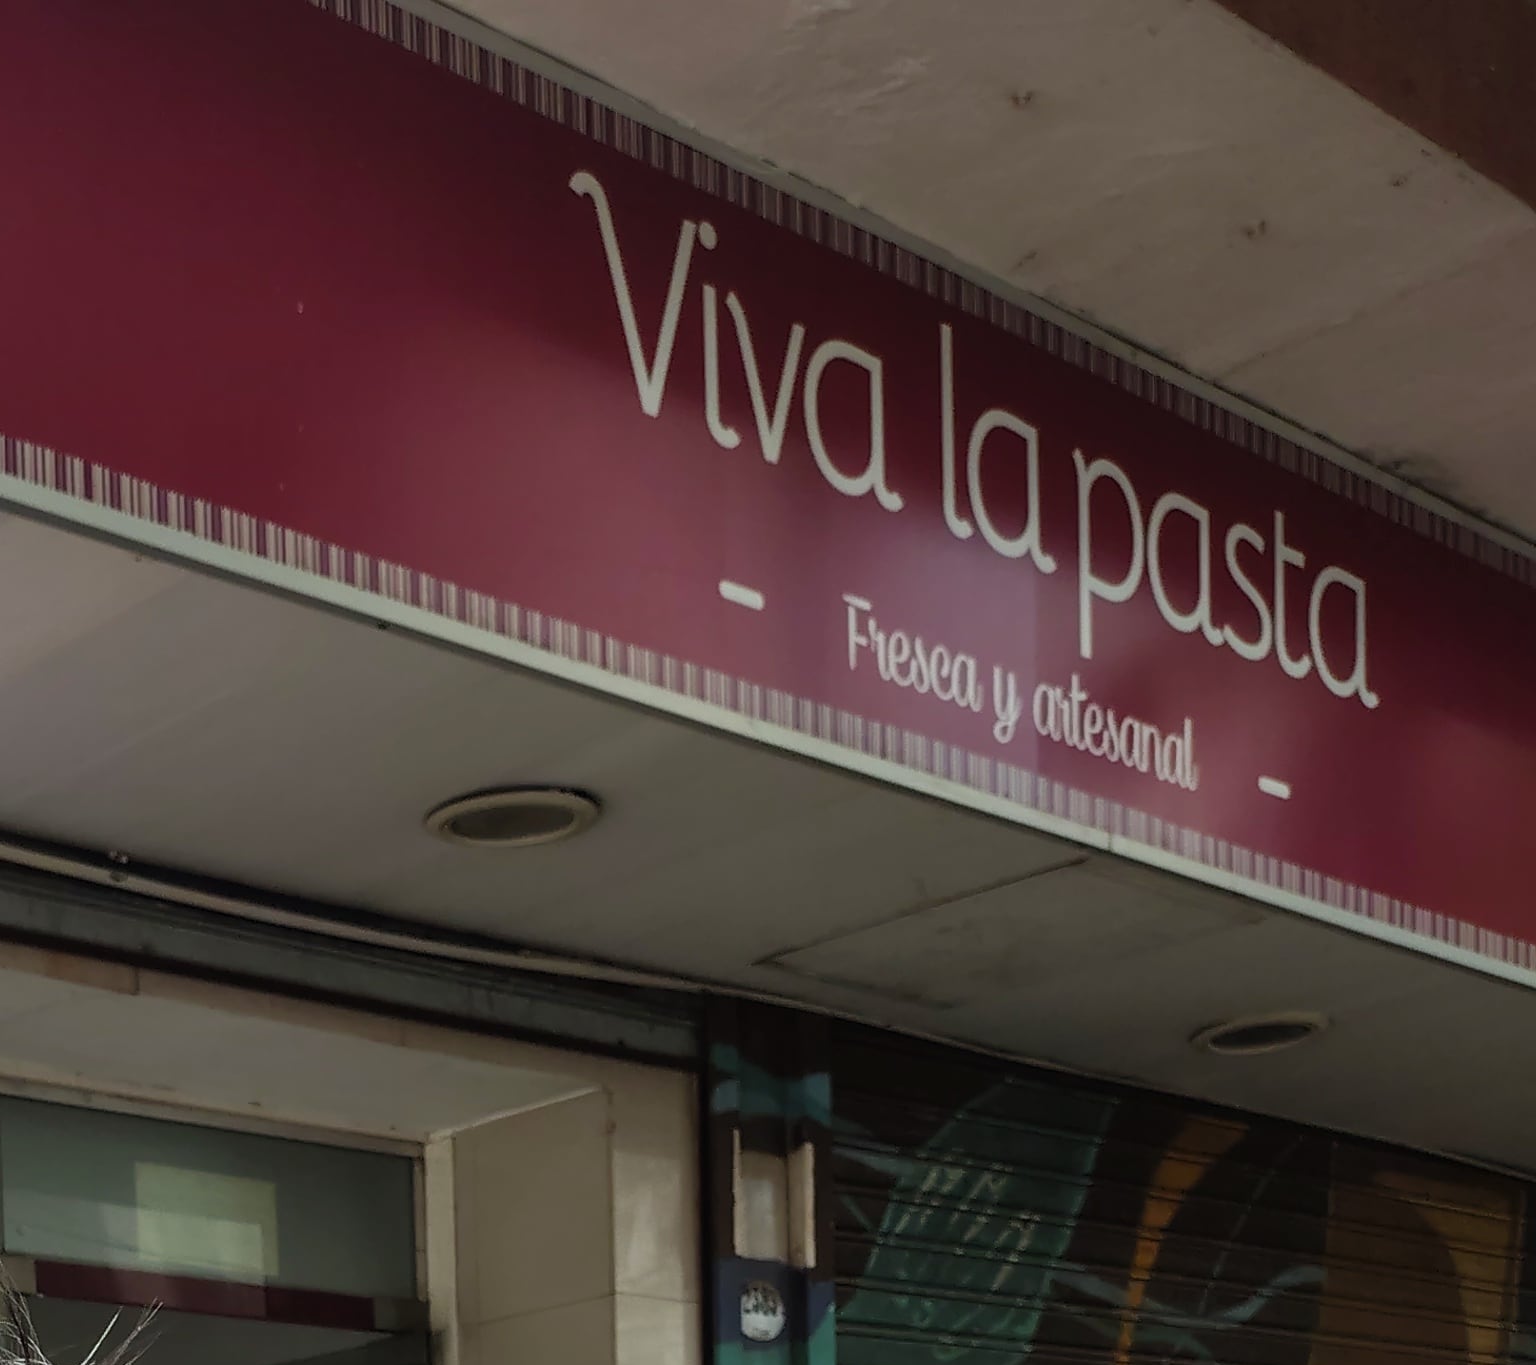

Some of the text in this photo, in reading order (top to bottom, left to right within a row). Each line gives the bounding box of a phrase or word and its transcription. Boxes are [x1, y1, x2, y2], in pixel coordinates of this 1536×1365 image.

[568, 171, 1380, 711] Viva la pasta
[842, 593, 1201, 793] Fresca y artesanal
